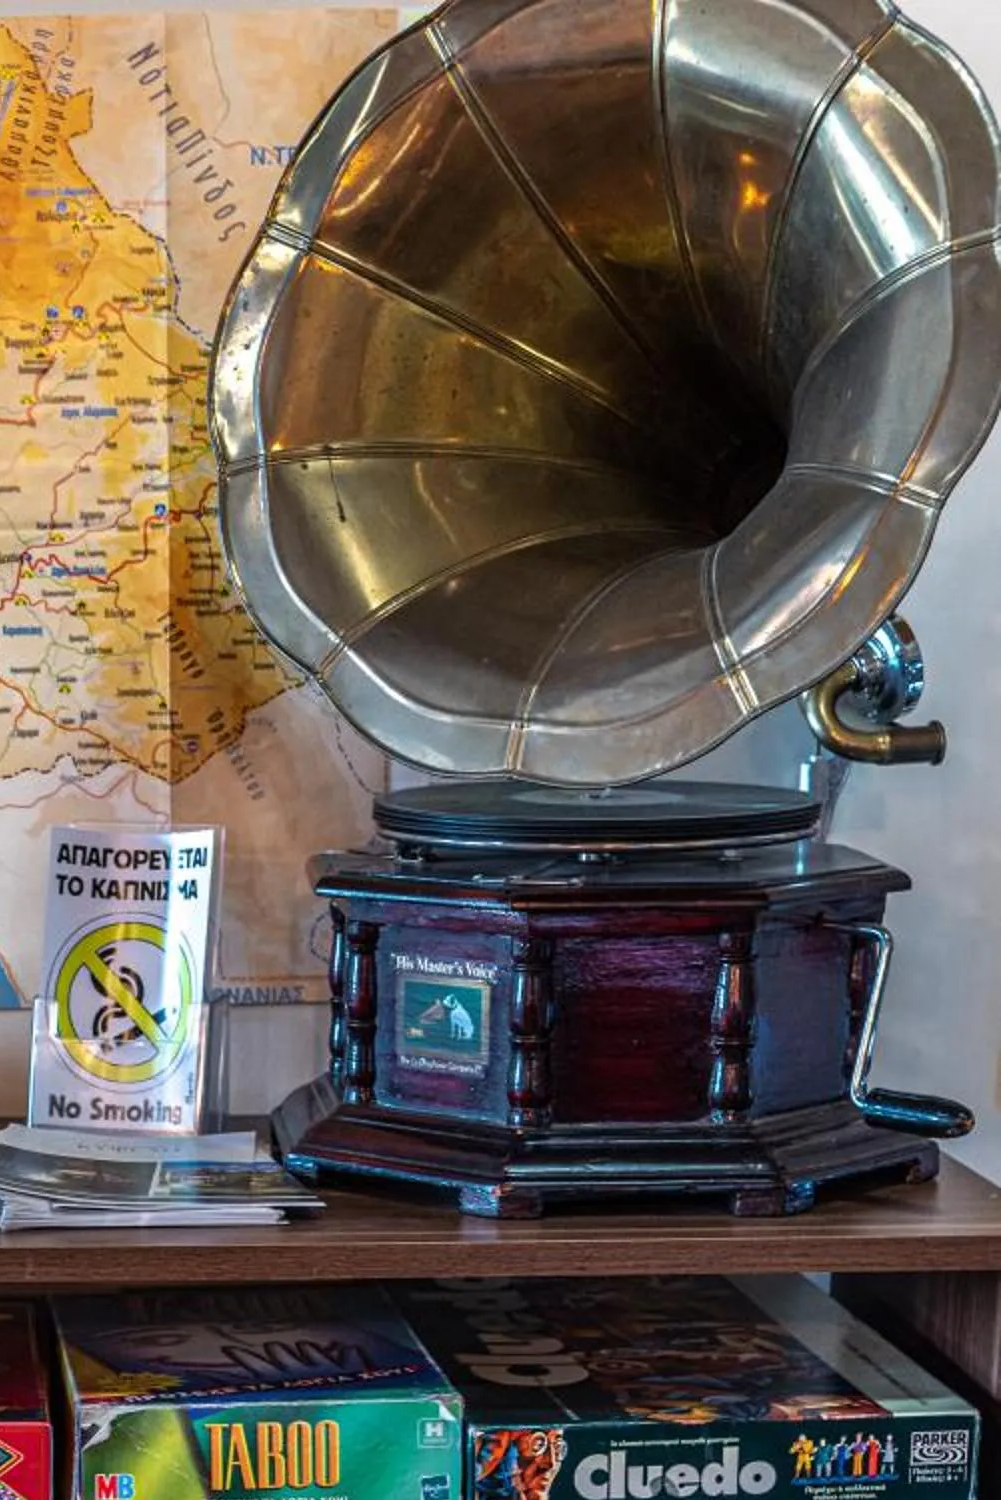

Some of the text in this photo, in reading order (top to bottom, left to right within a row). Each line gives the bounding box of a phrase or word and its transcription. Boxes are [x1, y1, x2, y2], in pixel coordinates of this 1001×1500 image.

[56, 874, 84, 896] ΤΟ
[49, 1095, 183, 1124] No Smoking
[912, 1431, 967, 1446] PARKER
[204, 1419, 341, 1491] TABOO
[95, 1473, 135, 1500] MB
